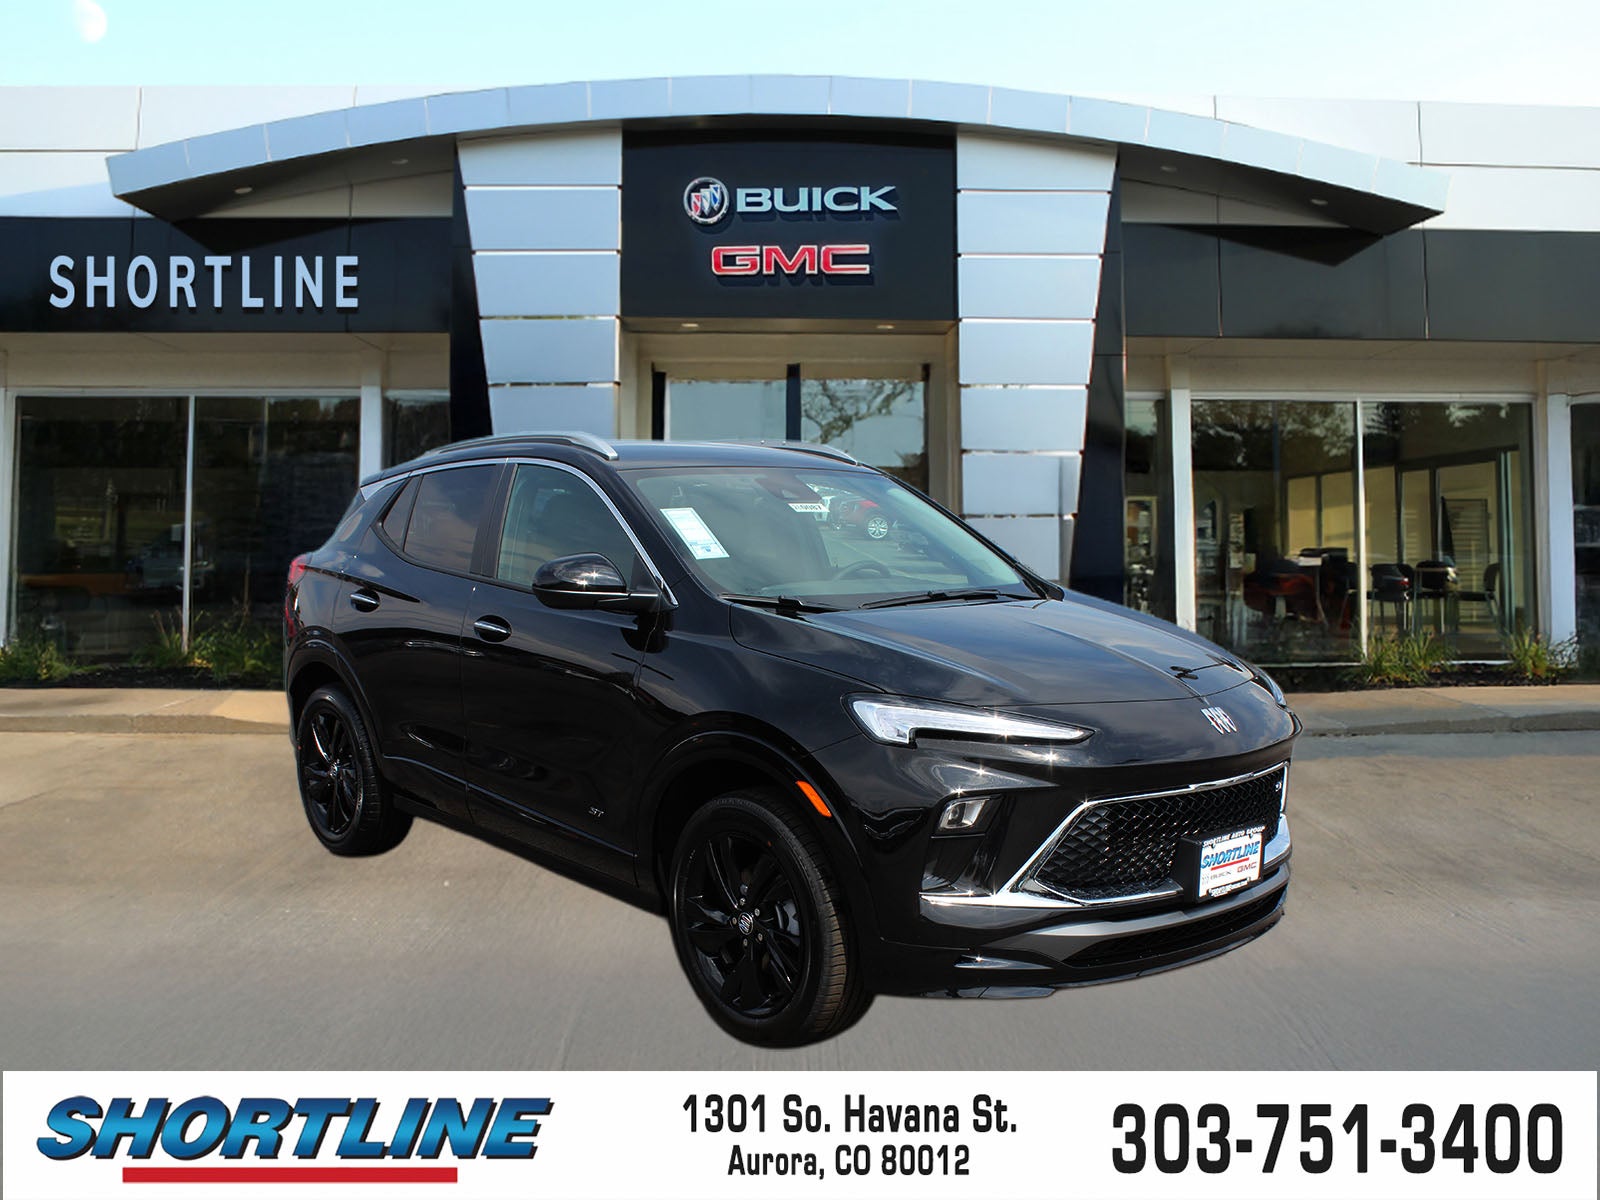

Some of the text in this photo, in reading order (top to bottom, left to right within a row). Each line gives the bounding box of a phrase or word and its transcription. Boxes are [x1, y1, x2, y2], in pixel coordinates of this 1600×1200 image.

[736, 186, 898, 212] BUICK
[711, 244, 870, 275] GMC
[49, 255, 358, 308] SHORTLINE
[1201, 841, 1260, 869] SHORTLINE
[1237, 861, 1257, 873] GMC
